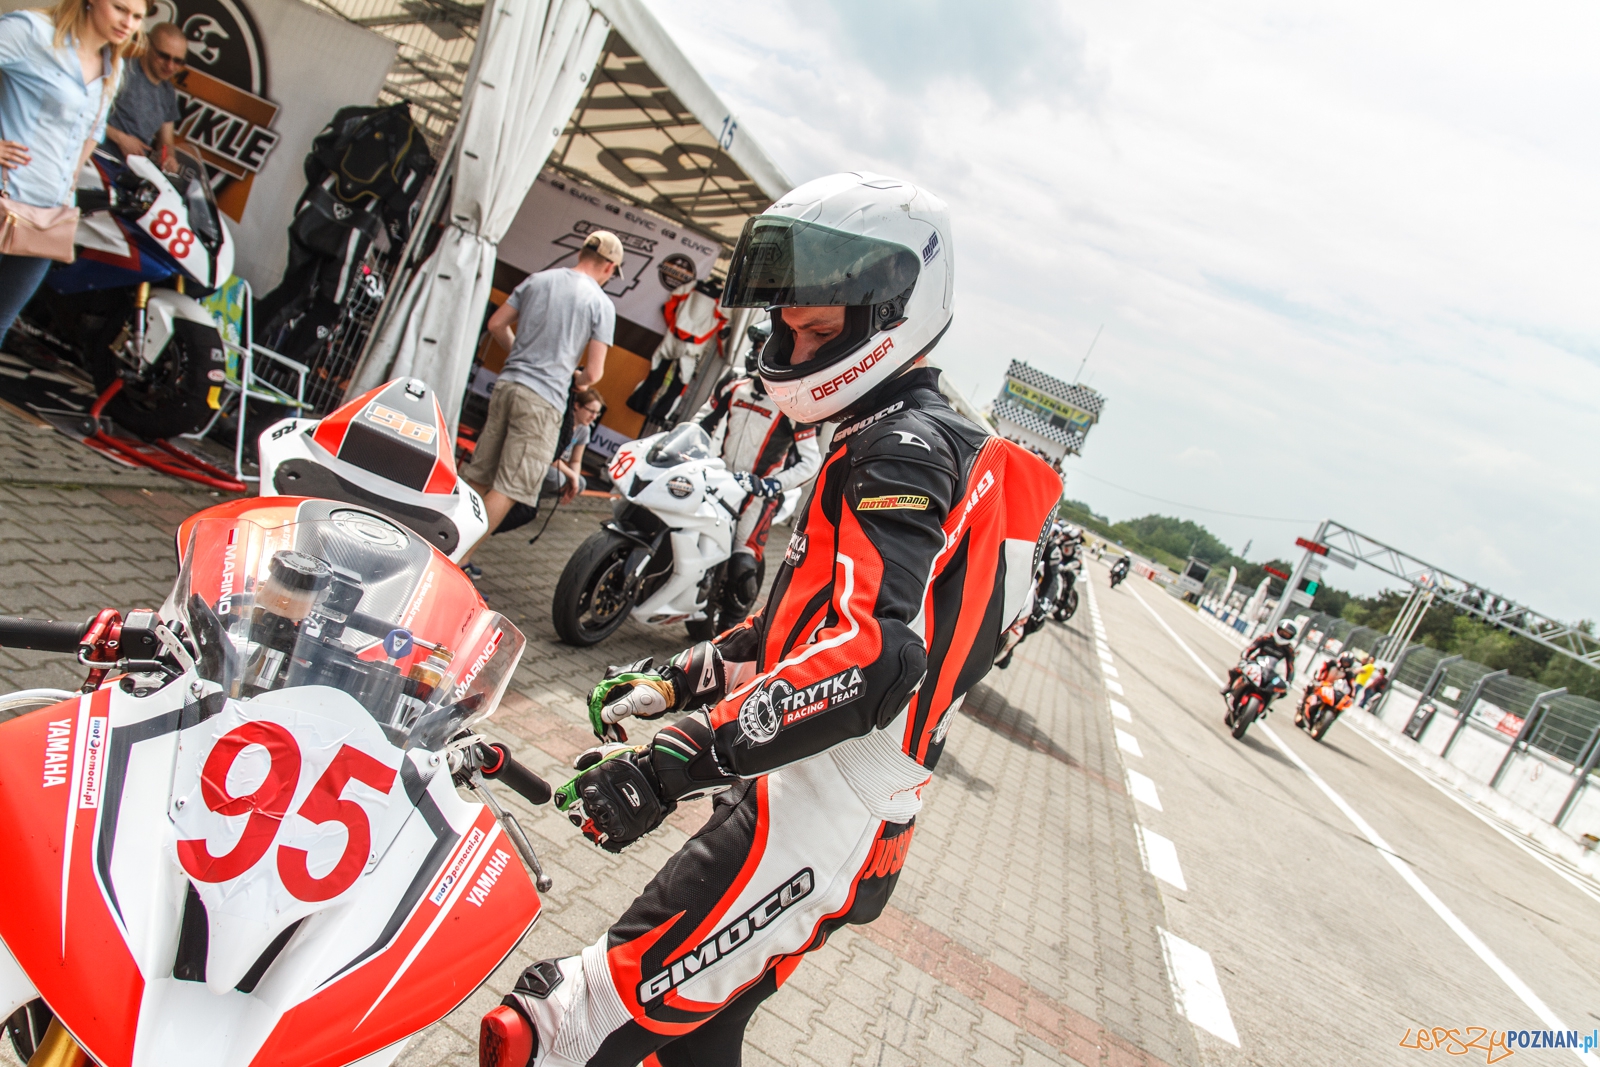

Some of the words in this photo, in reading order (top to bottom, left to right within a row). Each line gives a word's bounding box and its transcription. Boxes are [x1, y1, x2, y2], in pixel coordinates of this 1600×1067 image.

[718, 115, 739, 151] 15
[149, 209, 195, 259] 88
[810, 336, 894, 402] DEFENDER
[218, 544, 239, 616] MARINO
[454, 641, 497, 700] MARINO
[780, 668, 863, 712] TRYTKA
[787, 701, 825, 723] RACING
[830, 686, 859, 705] TEAM
[43, 718, 72, 788] YAMAHA
[176, 720, 398, 903] 95
[465, 848, 511, 908] YAMAHA
